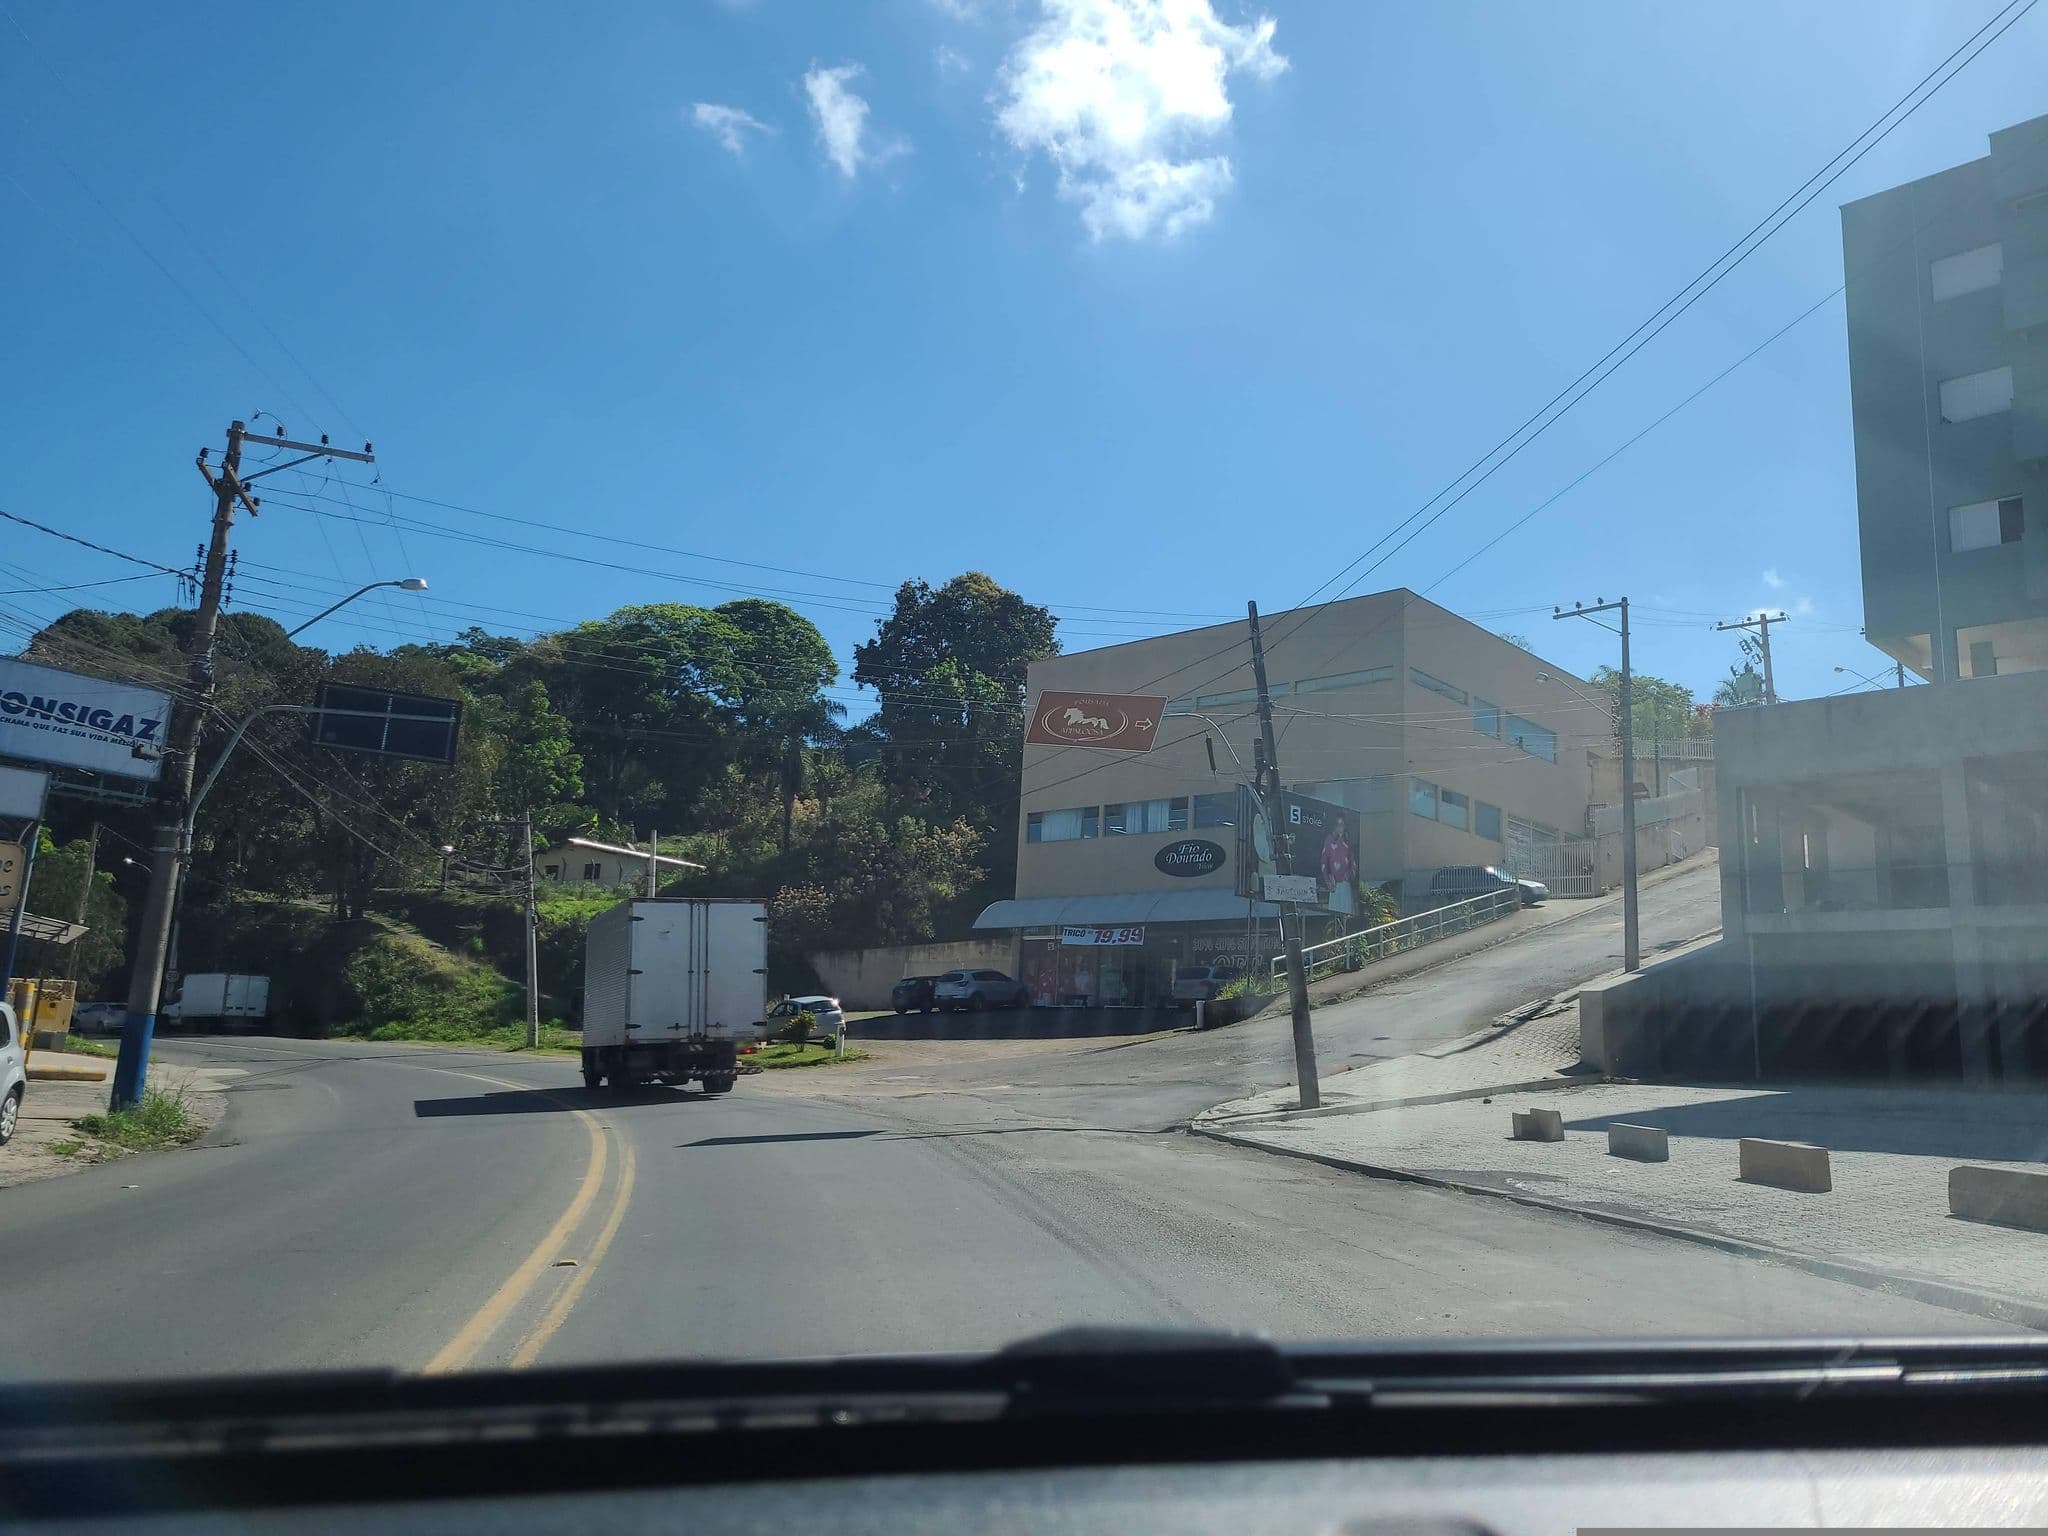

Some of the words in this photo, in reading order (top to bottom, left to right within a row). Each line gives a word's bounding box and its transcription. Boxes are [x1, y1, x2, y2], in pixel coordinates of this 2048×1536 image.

[0, 690, 162, 741] ONSIGAZ
[33, 722, 50, 731] QUE
[52, 725, 68, 735] FAZ
[70, 729, 87, 739] SUA
[88, 732, 109, 743] VIDA
[1165, 848, 1213, 864] Dourado
[1179, 843, 1200, 855] Fio
